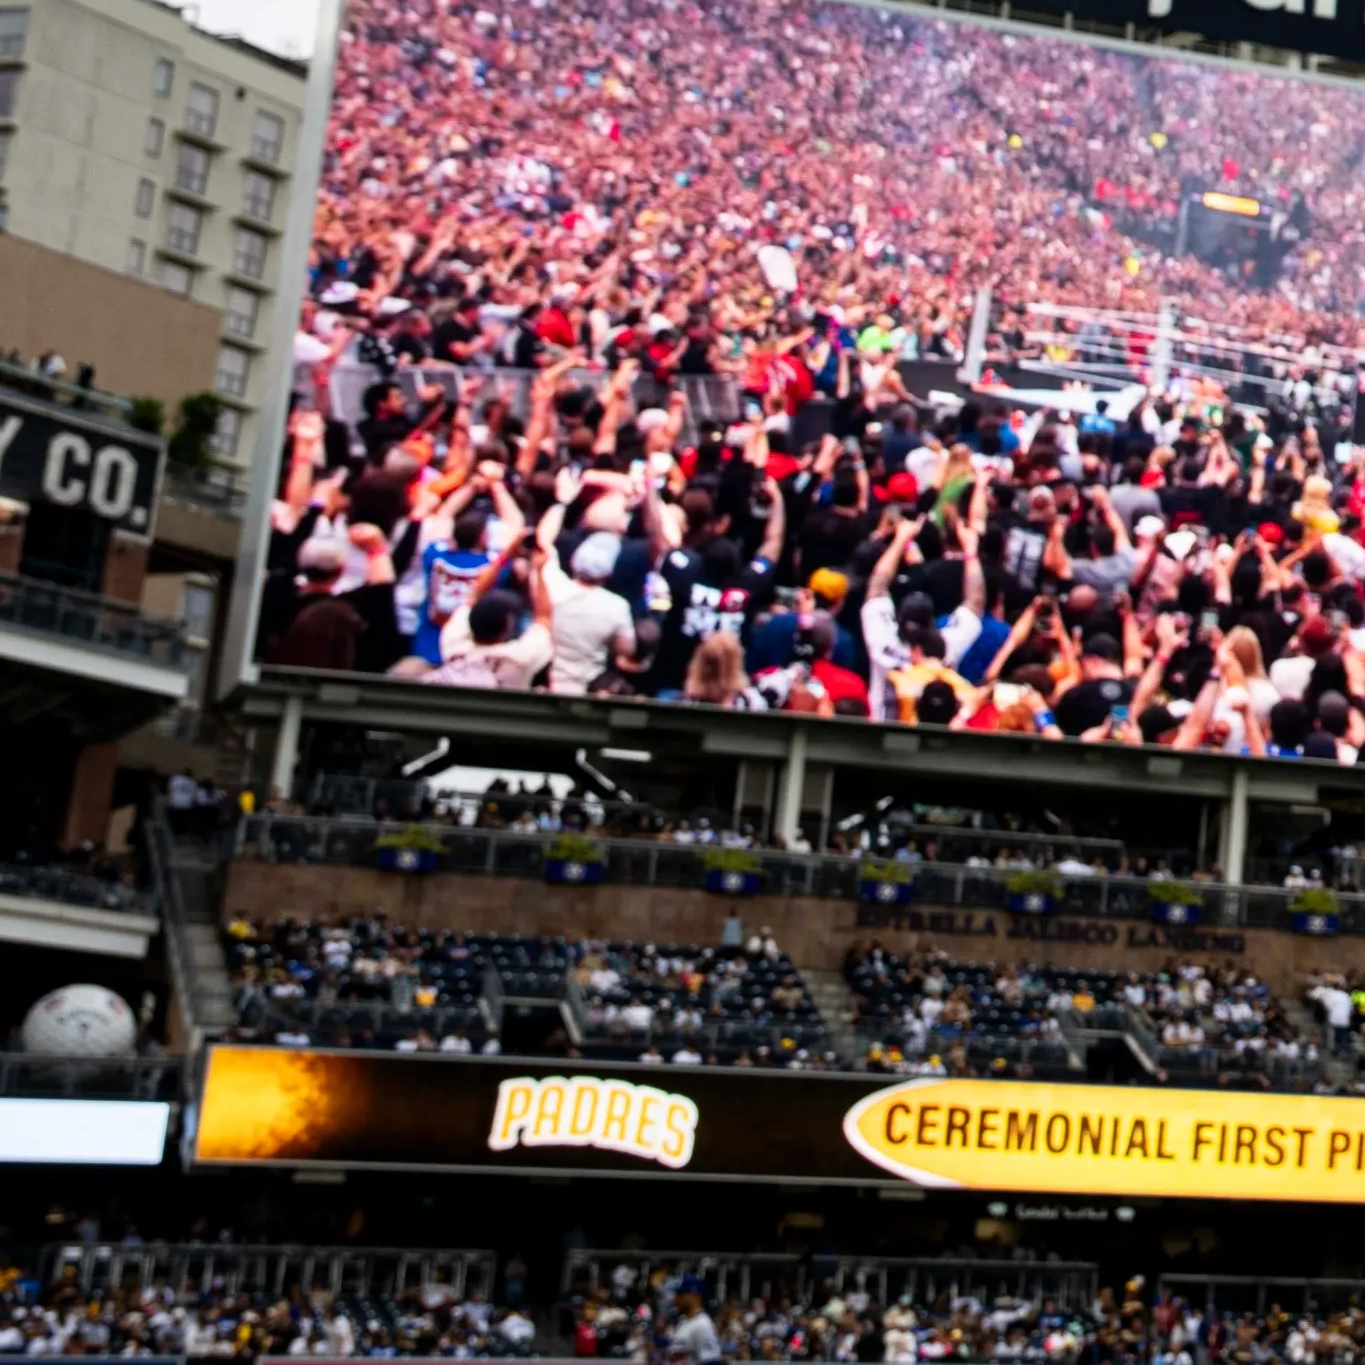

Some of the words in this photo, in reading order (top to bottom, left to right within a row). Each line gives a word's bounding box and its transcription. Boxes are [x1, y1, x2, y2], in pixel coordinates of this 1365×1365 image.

[43, 431, 148, 526] CO.
[493, 1079, 696, 1164] PADRES
[884, 1102, 1175, 1161] CEREMONIAL
[1192, 1122, 1314, 1168] FIRST
